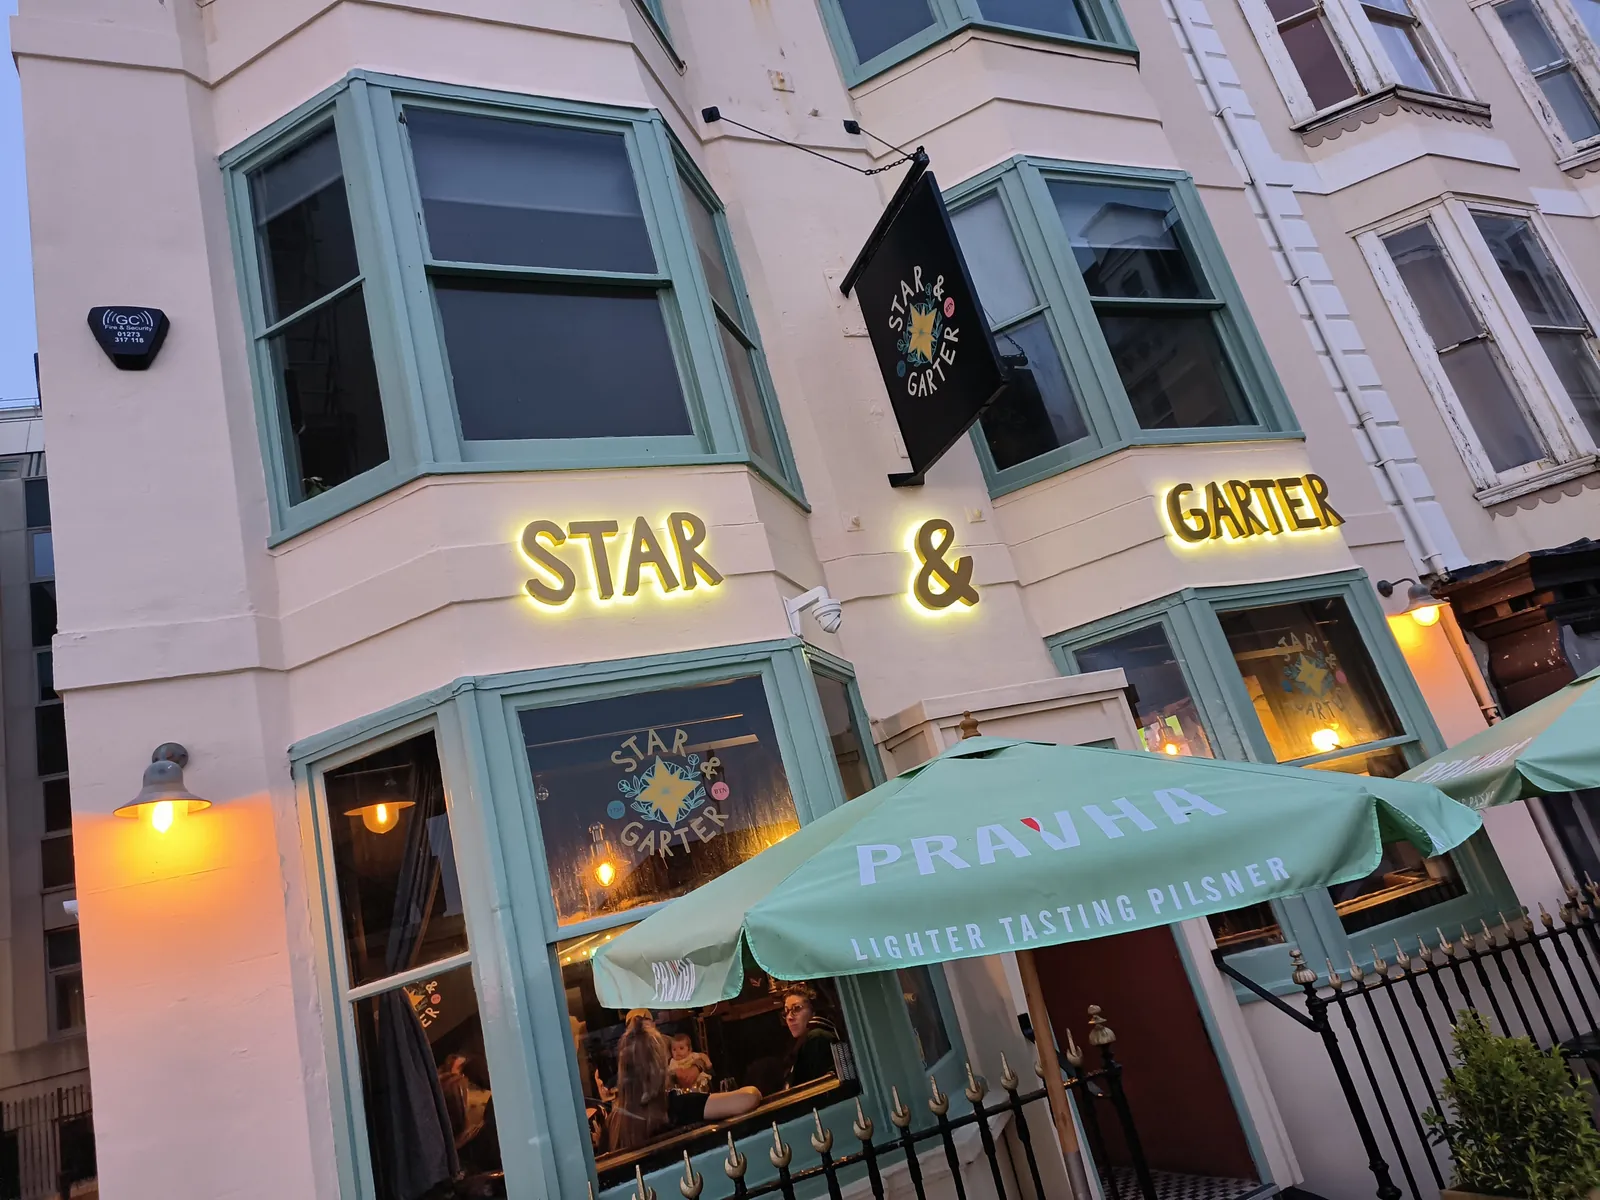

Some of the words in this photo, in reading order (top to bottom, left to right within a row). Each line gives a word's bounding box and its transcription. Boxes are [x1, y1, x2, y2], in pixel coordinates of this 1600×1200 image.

[116, 314, 140, 325] GC
[889, 265, 925, 332] STAR
[933, 274, 945, 302] &
[907, 326, 960, 398] GARTER
[521, 511, 725, 606] STAR
[913, 518, 980, 611] &
[1166, 473, 1346, 543] GARTER
[610, 728, 688, 773] STAR
[700, 756, 721, 780] &
[620, 806, 729, 857] GARTER
[856, 787, 1228, 886] PRAVHA
[851, 923, 986, 961] LIGHTER
[998, 894, 1137, 945] TASTING
[1147, 857, 1290, 914] PILSNER
